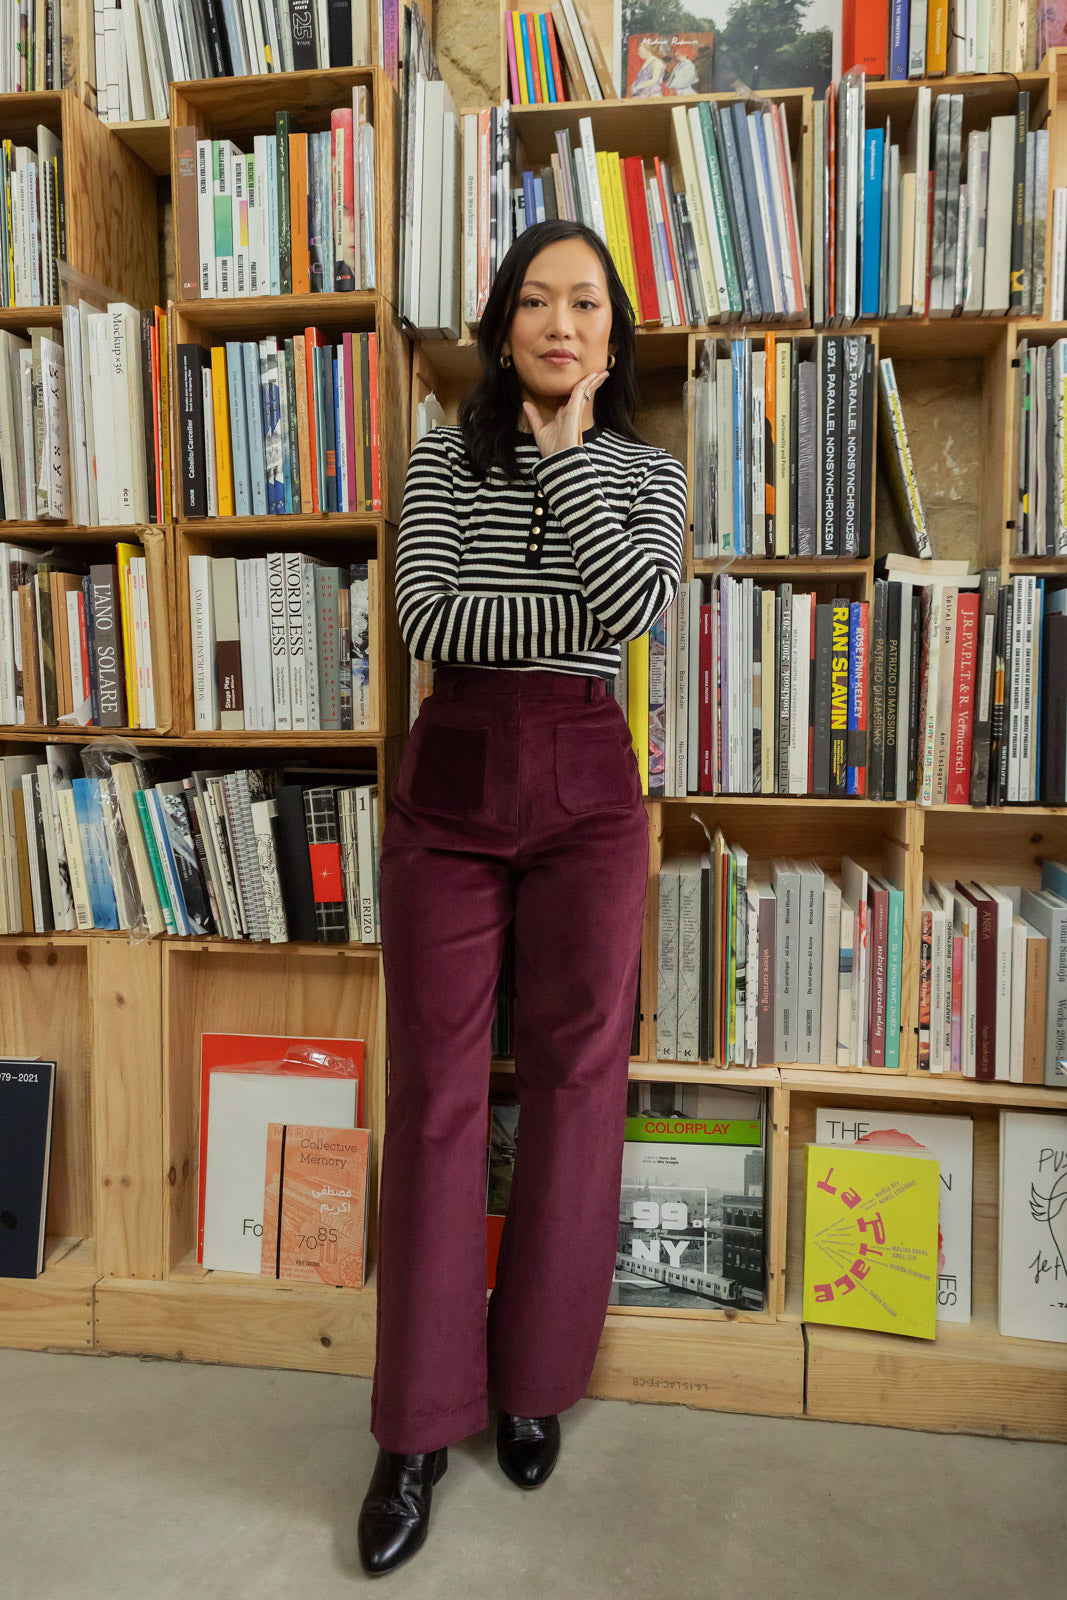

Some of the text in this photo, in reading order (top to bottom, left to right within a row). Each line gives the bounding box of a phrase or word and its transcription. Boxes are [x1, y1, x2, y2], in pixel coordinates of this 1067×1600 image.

[848, 373, 857, 435] PARALLEL
[779, 415, 787, 448] Functionality
[825, 340, 836, 551] 1971. PARALLEL NONSYNCHRONISM
[844, 437, 856, 552] NONSYNCHRONISM
[269, 556, 287, 656] WORDLESS
[287, 556, 304, 656] WORDLESS
[944, 594, 954, 643] Spiral Book
[833, 607, 849, 652] RAN
[97, 646, 118, 714] SOLARE
[781, 611, 792, 718] Bookbook 2007 2011
[854, 628, 865, 719] ROSE FINN-KELCEY
[874, 638, 885, 683] PATRIZIO
[197, 672, 206, 702] NORMA
[831, 657, 849, 730] SLAVIN
[886, 639, 898, 746] PATRIZIO DI MASSIMO
[873, 698, 884, 746] MASSIMO
[954, 712, 969, 775] Vermeersch
[360, 797, 367, 811] 1
[363, 897, 373, 935] ERIZO
[763, 948, 771, 971] where
[761, 973, 771, 1004] curating
[1056, 999, 1067, 1028] Works
[300, 1139, 358, 1153] Collective
[645, 1122, 730, 1135] COLORPLAY
[826, 1121, 869, 1141] THE
[300, 1154, 347, 1169] Memory
[633, 1201, 688, 1230] 99
[632, 1239, 690, 1268] NY
